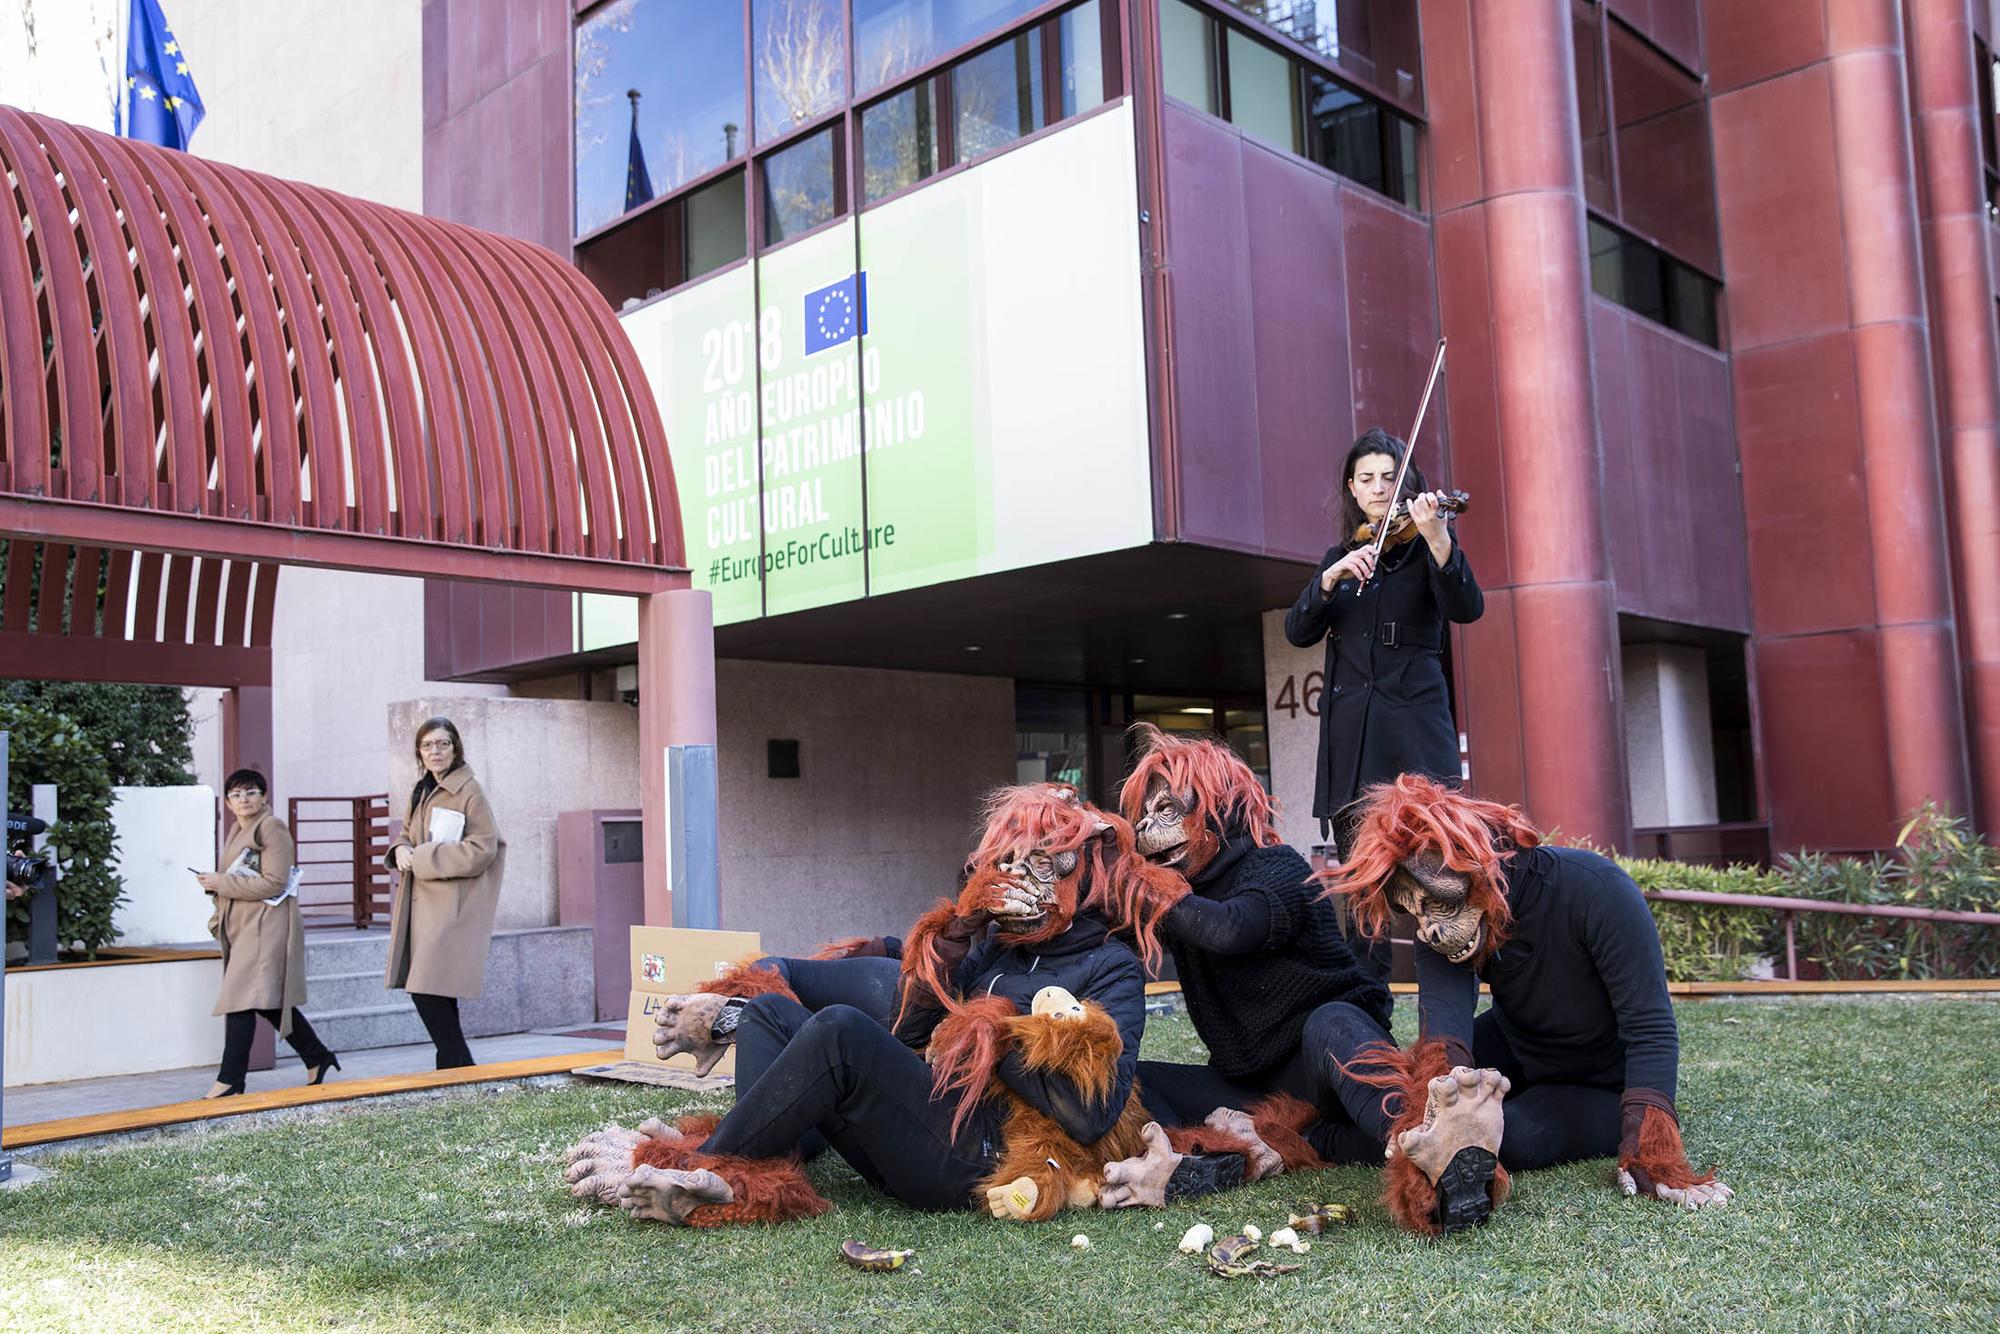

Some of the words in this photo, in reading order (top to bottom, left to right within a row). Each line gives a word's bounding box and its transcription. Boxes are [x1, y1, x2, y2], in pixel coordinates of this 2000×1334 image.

[703, 305, 782, 393] 208
[705, 390, 752, 446] AÑO
[705, 447, 750, 497] DEL
[753, 390, 925, 483] PATRIMONIO
[1275, 670, 1324, 719] 46
